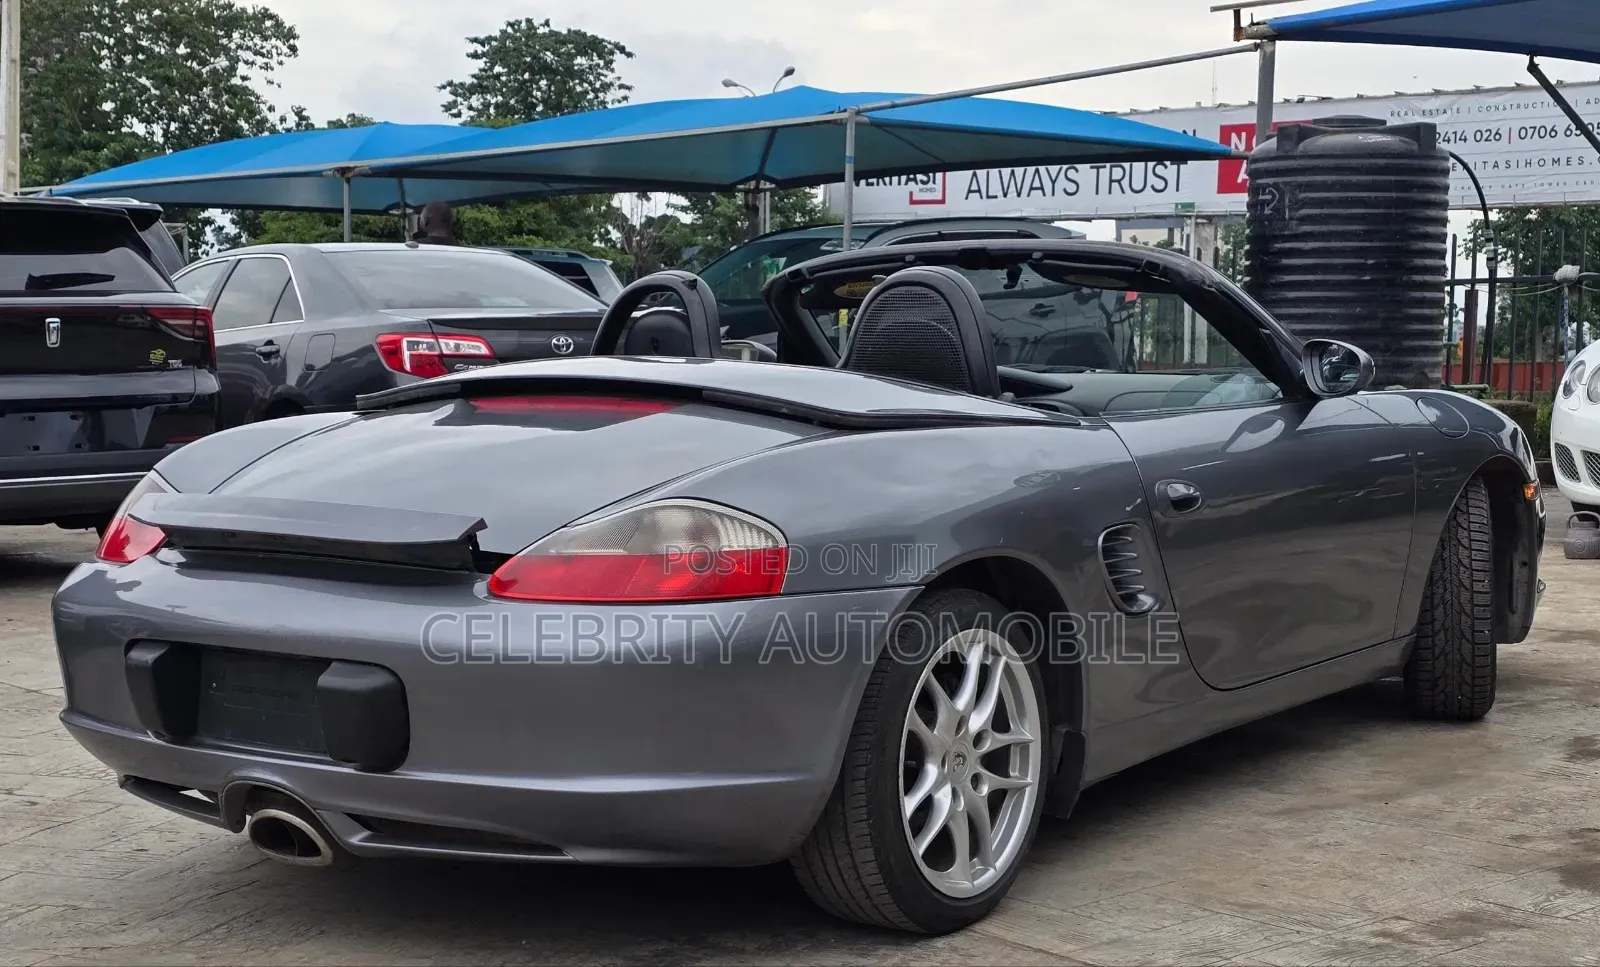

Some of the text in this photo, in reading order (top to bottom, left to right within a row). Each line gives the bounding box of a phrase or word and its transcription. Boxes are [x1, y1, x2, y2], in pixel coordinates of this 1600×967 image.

[1422, 107, 1460, 116] ESTATE
[1478, 101, 1558, 113] CONSTRUCTIO
[1231, 131, 1256, 152] N
[1436, 130, 1468, 144] 2414
[1474, 128, 1502, 143] 026
[1518, 124, 1558, 140] 0706
[965, 160, 1188, 200] ALWAYS TRUST
